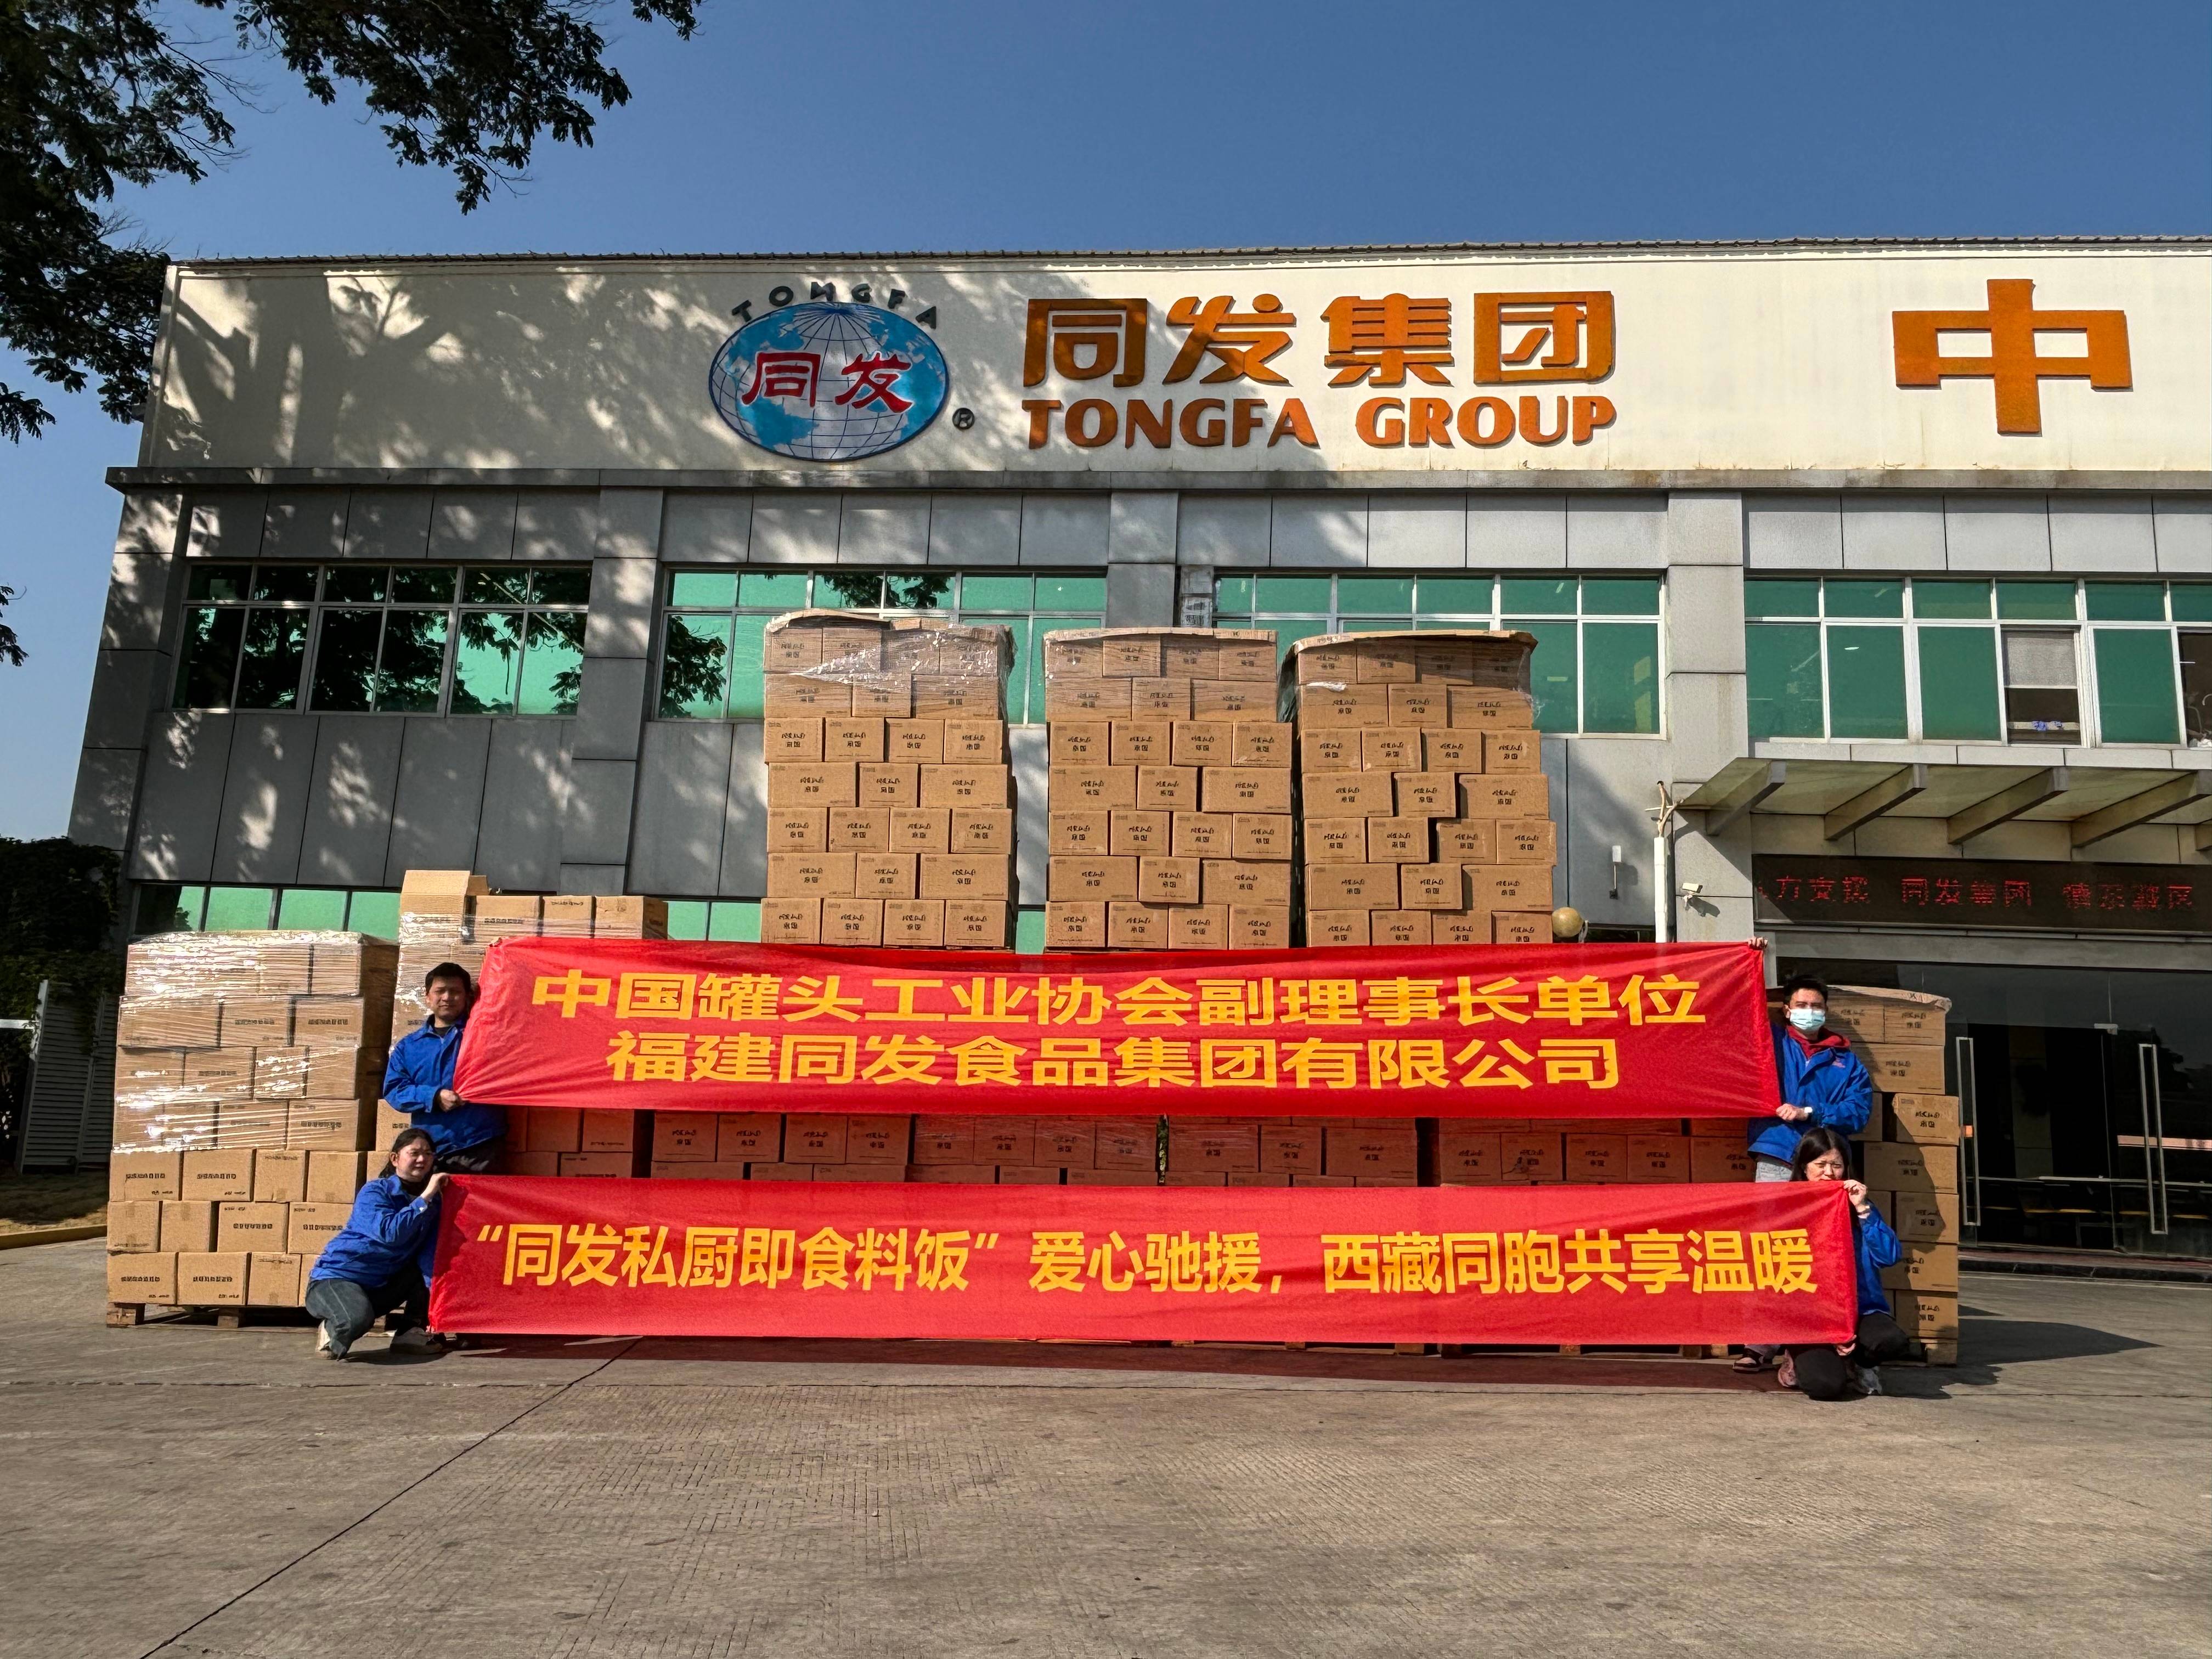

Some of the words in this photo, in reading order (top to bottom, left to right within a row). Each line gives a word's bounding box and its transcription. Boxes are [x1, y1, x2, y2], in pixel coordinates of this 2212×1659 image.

[1023, 291, 1615, 387] 同发集团
[1892, 279, 2133, 437] 中
[741, 352, 913, 413] 同发
[1022, 397, 1320, 449] TONGFA
[1355, 395, 1616, 448] GROUP
[532, 969, 1706, 1027] 中国罐头工业协会副理事长单位
[606, 1030, 1619, 1090] 福建同发食品集团有限公司
